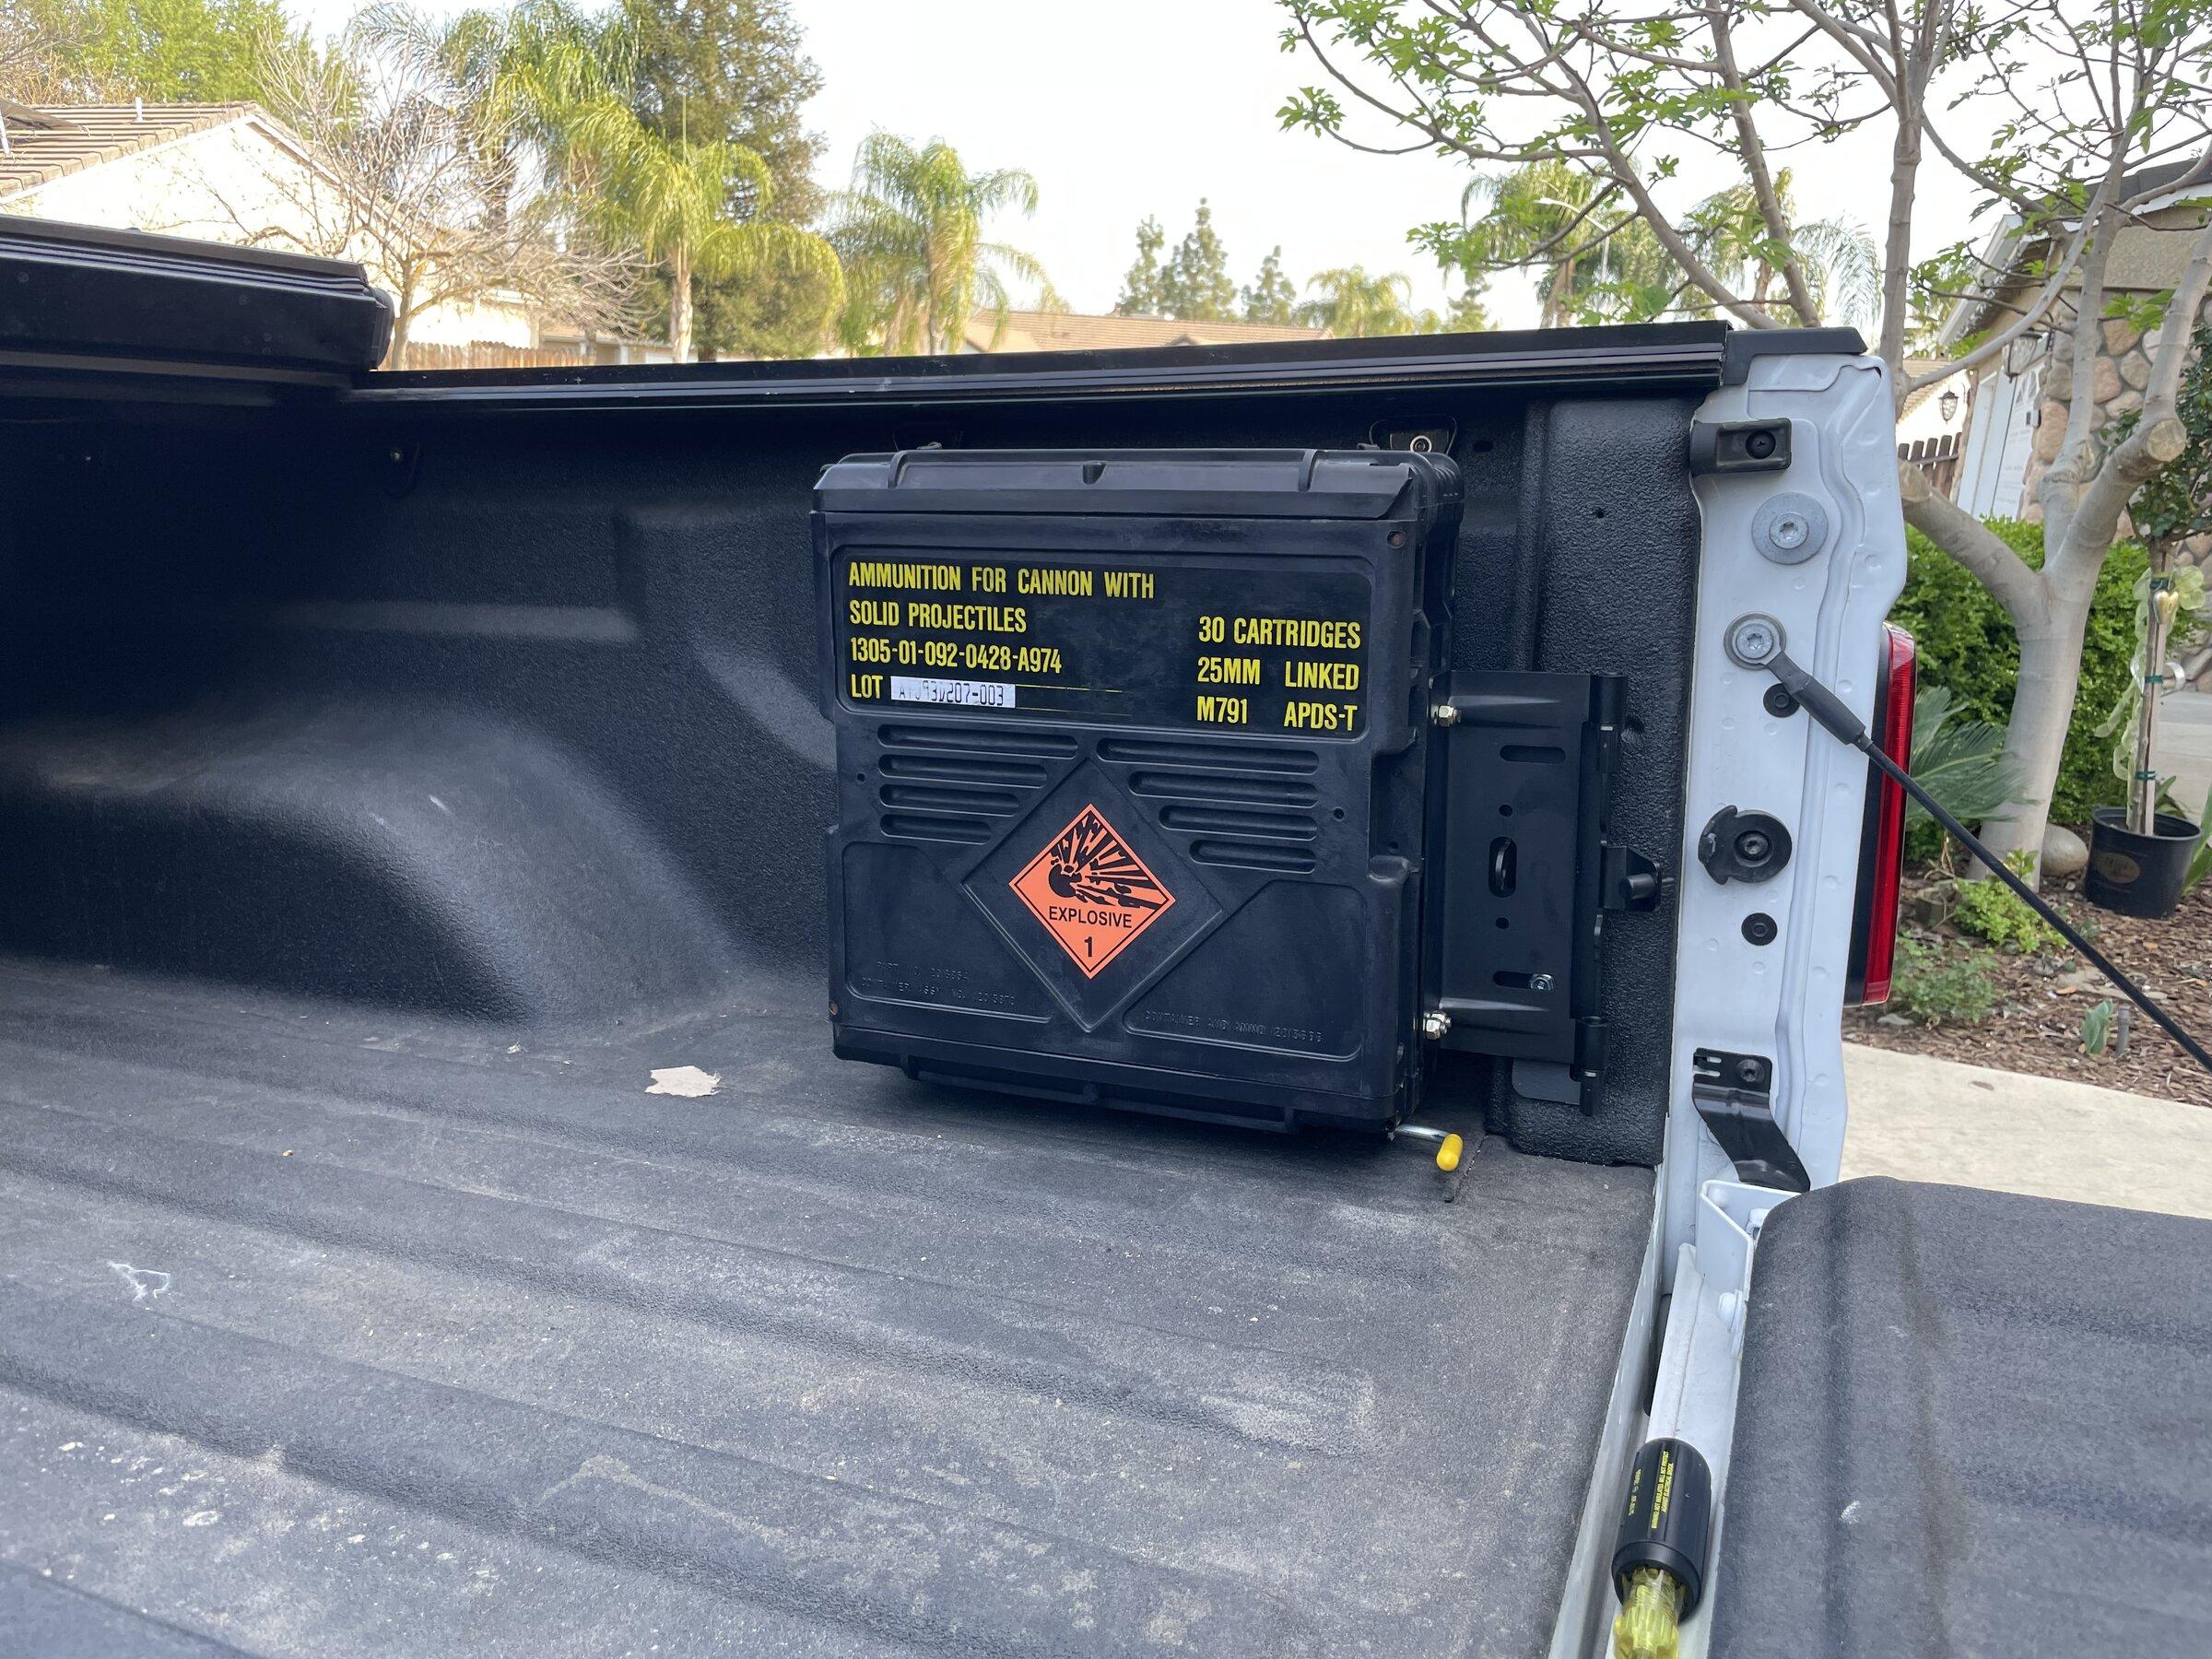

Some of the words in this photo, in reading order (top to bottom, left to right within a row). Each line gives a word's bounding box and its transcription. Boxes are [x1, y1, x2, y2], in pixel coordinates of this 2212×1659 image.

[848, 561, 961, 591] AMMUNITION
[972, 566, 1006, 593] FOR
[1018, 568, 1093, 596] CANNON
[1103, 571, 1155, 599] WITH
[849, 599, 900, 627] SOLID
[908, 602, 1027, 633] PROJECTILES
[1198, 616, 1225, 643] 30
[1233, 618, 1361, 650] CARTRIDGES
[850, 637, 1062, 674] 1305-01-092-0428-A974
[851, 674, 883, 699] LOT
[1197, 656, 1261, 685] 25MM
[1285, 661, 1359, 690] LINKED
[1196, 696, 1248, 724] M791
[1283, 701, 1358, 731] APDS-T
[1049, 906, 1133, 929] EXPLOSIVE
[1084, 935, 1093, 958] 1
